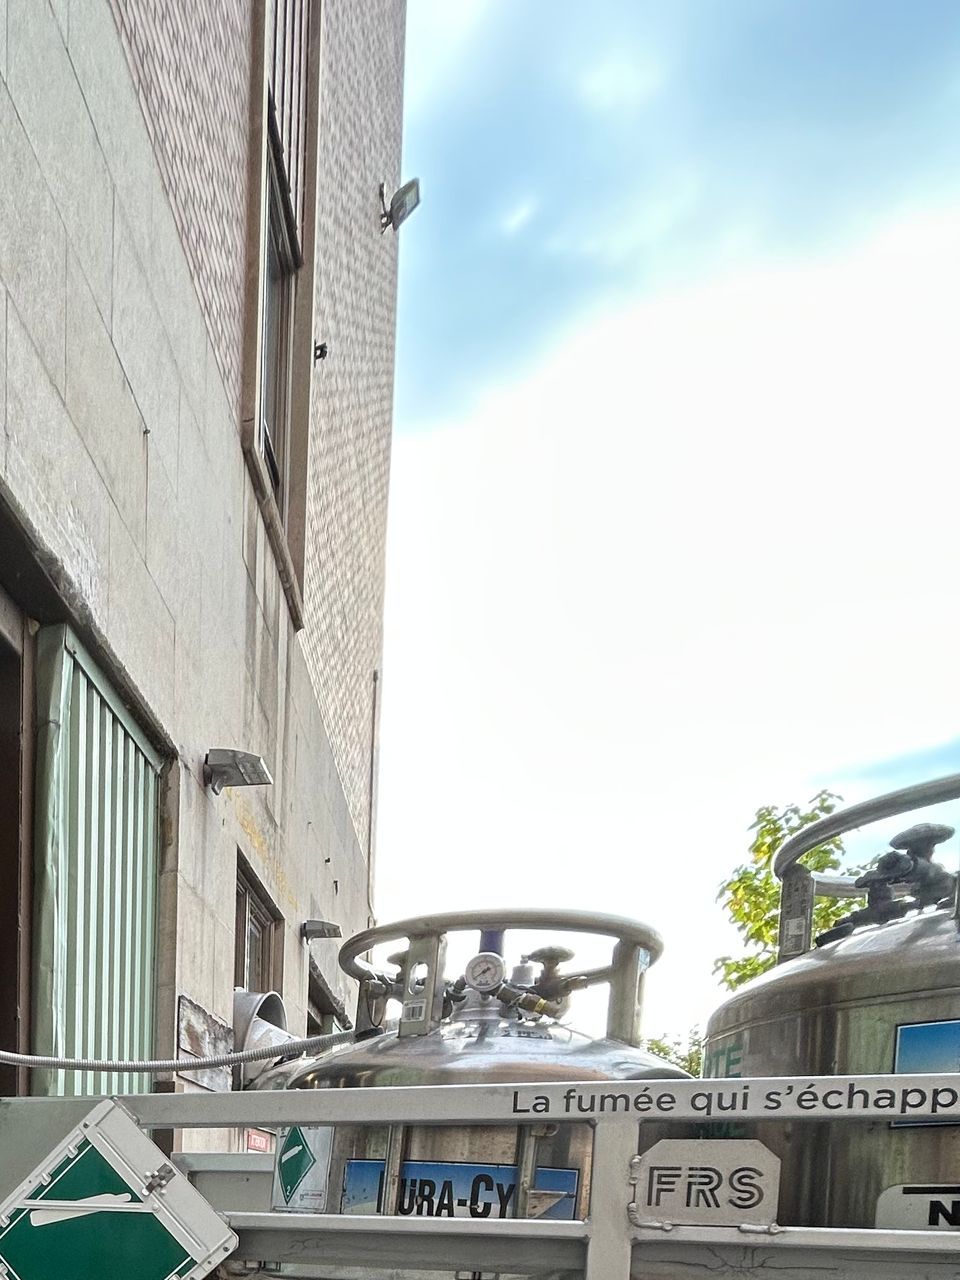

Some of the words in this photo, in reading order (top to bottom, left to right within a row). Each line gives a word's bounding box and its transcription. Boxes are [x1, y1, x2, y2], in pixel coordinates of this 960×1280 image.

[513, 1090, 550, 1114] La
[563, 1087, 676, 1113] fumée
[690, 1085, 750, 1116] qui
[376, 1171, 517, 1219] URA-CY
[647, 1166, 764, 1209] FRS
